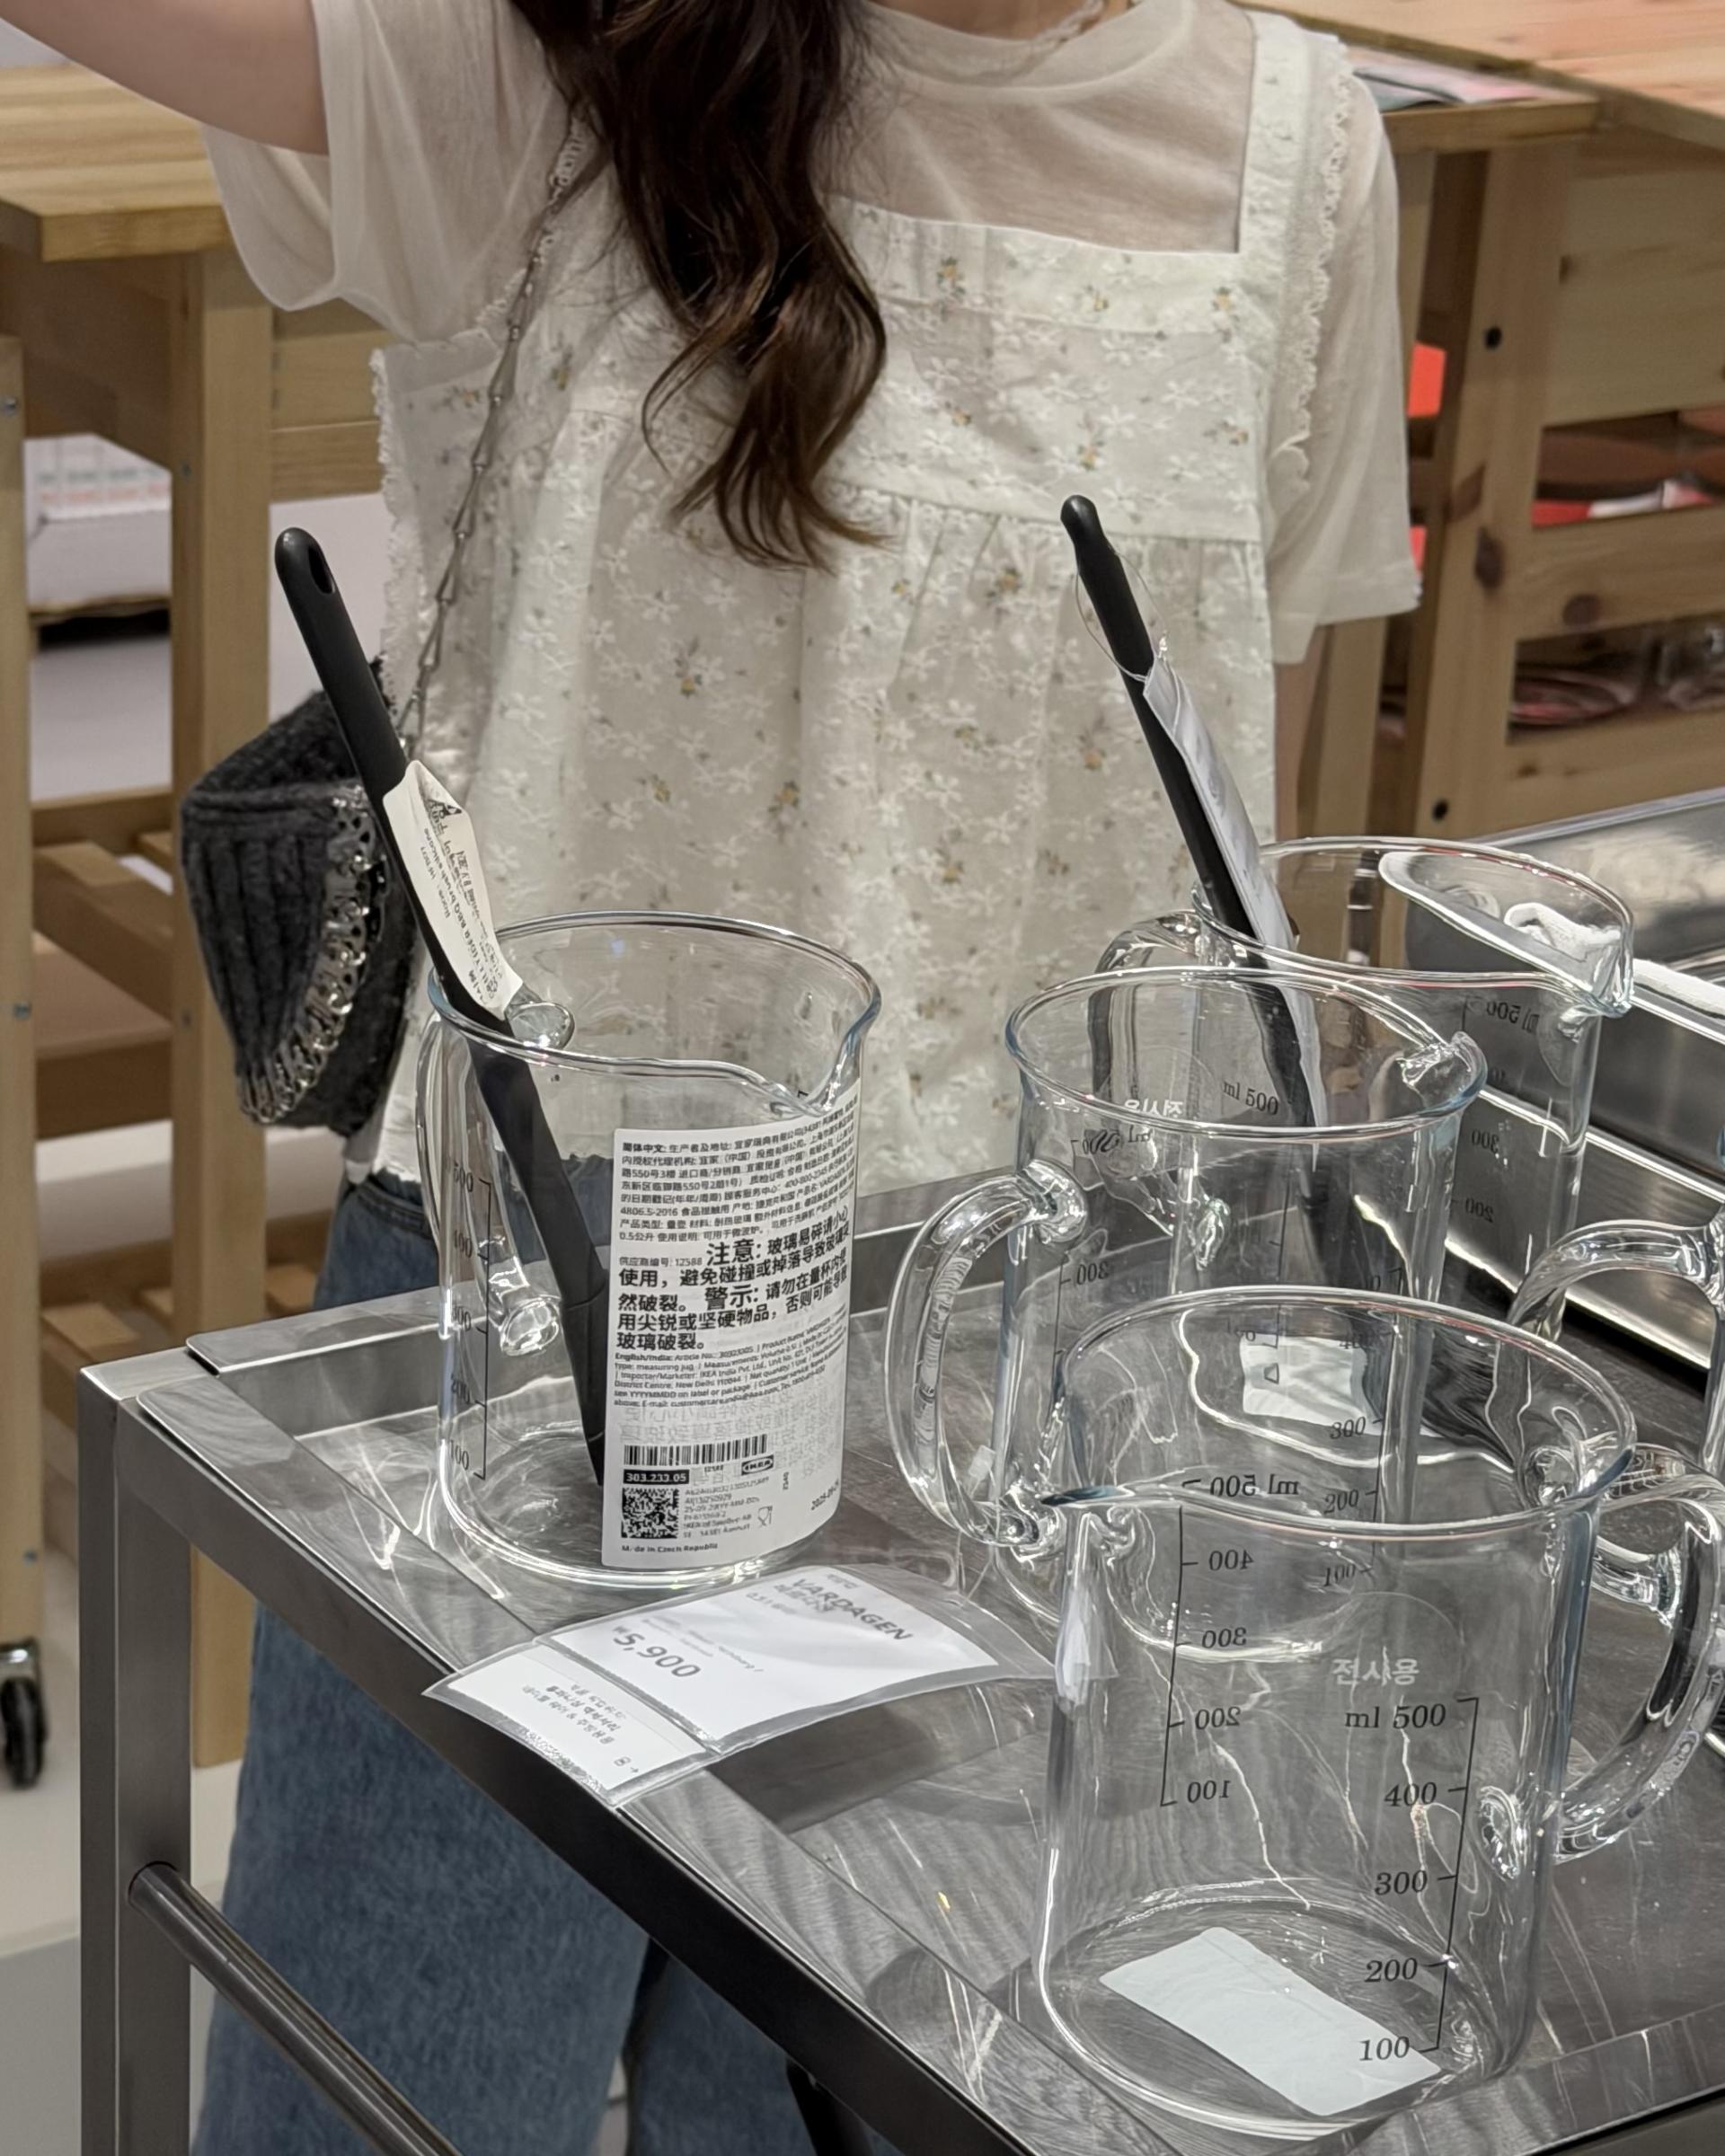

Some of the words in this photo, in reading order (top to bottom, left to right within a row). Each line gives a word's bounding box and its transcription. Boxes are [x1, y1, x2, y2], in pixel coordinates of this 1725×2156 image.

[1245, 1088, 1279, 1116] 500
[675, 1257, 703, 1267] 12588
[1331, 1416, 1367, 1440] 300
[1323, 1489, 1359, 1515] 200
[658, 1545, 682, 1553] Czech
[792, 1578, 913, 1640] VARDAGEN
[1345, 1706, 1380, 1728] ml
[1393, 1703, 1446, 1730] 500
[1384, 1781, 1437, 1807] 400
[1374, 1871, 1429, 1895] 300
[1364, 1957, 1418, 1983] 200
[1359, 2036, 1410, 2061] 100
